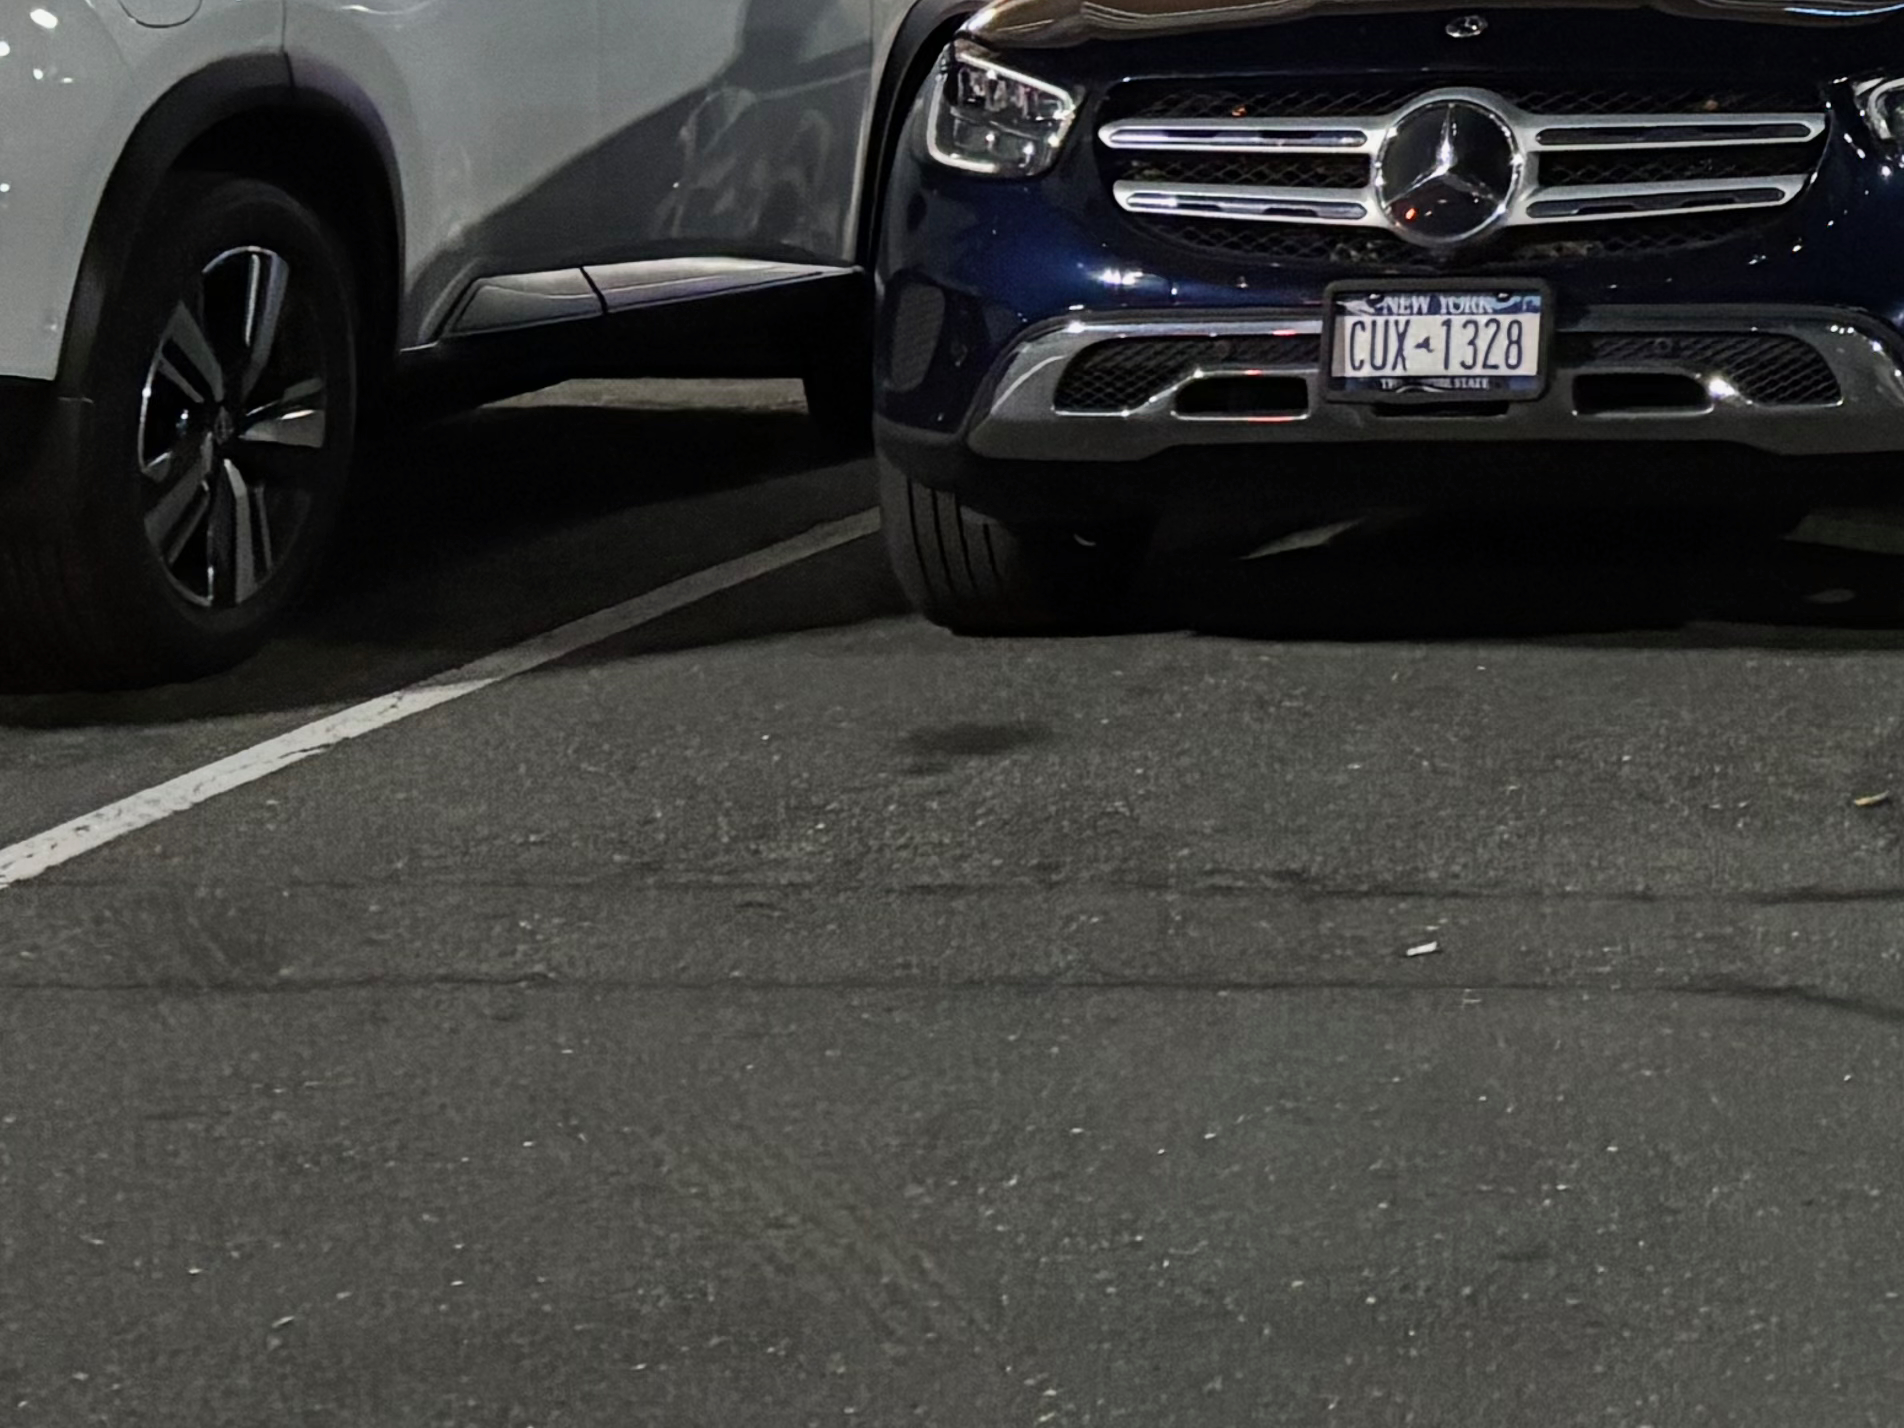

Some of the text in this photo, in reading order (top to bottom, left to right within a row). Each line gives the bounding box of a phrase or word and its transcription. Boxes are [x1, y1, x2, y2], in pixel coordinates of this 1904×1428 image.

[1381, 294, 1494, 315] NEW YORK
[1349, 318, 1524, 372] CUX 1328
